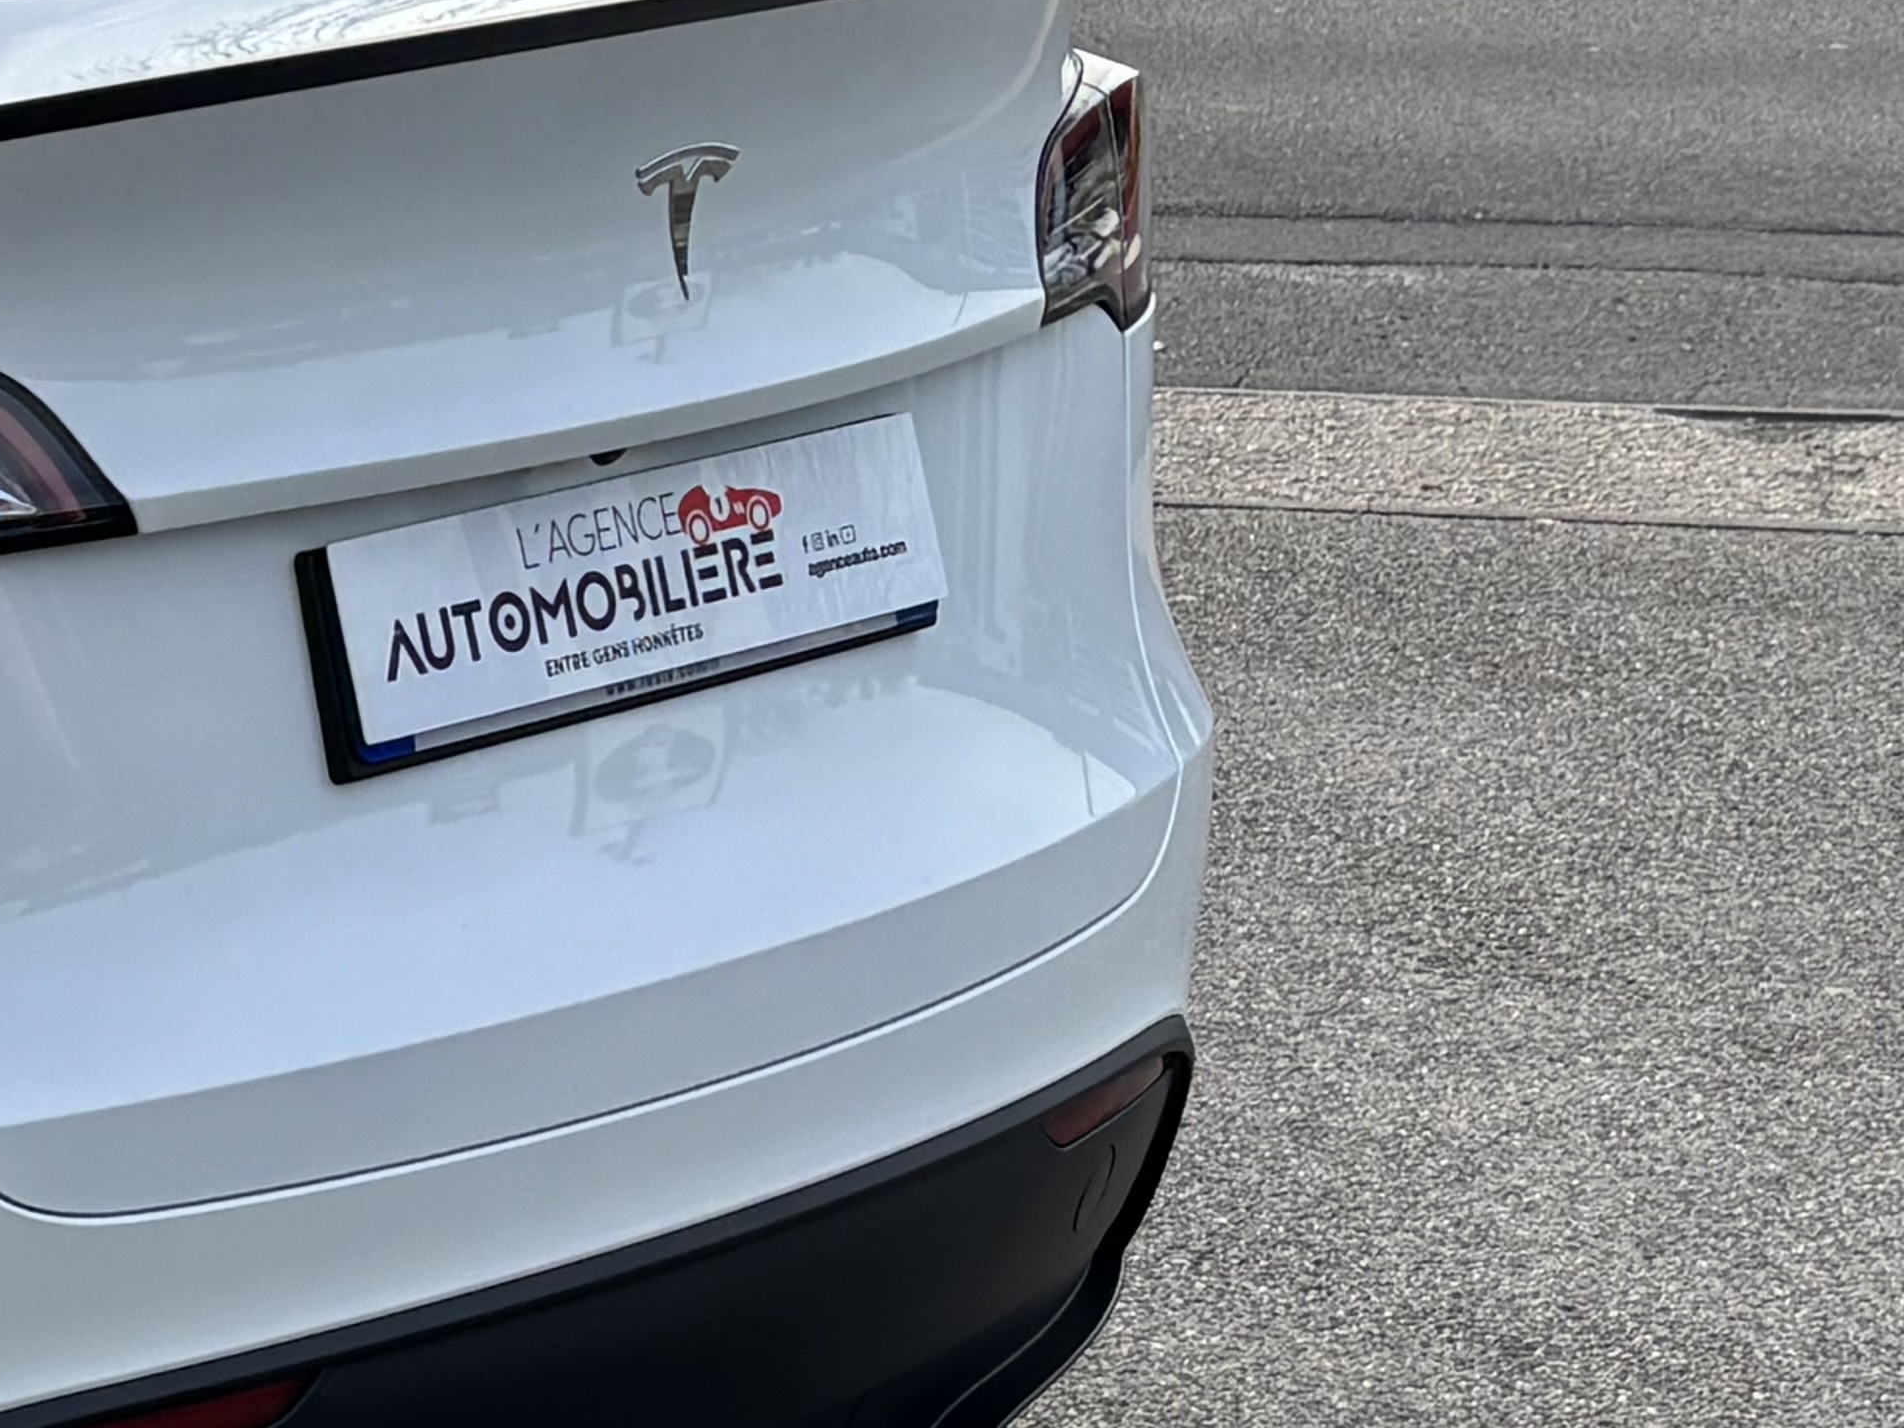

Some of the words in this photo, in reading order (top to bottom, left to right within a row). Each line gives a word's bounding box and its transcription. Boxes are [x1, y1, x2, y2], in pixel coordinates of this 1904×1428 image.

[517, 492, 682, 570] L'AGENCE
[545, 651, 590, 678] ENTRE
[592, 641, 631, 665] GENS
